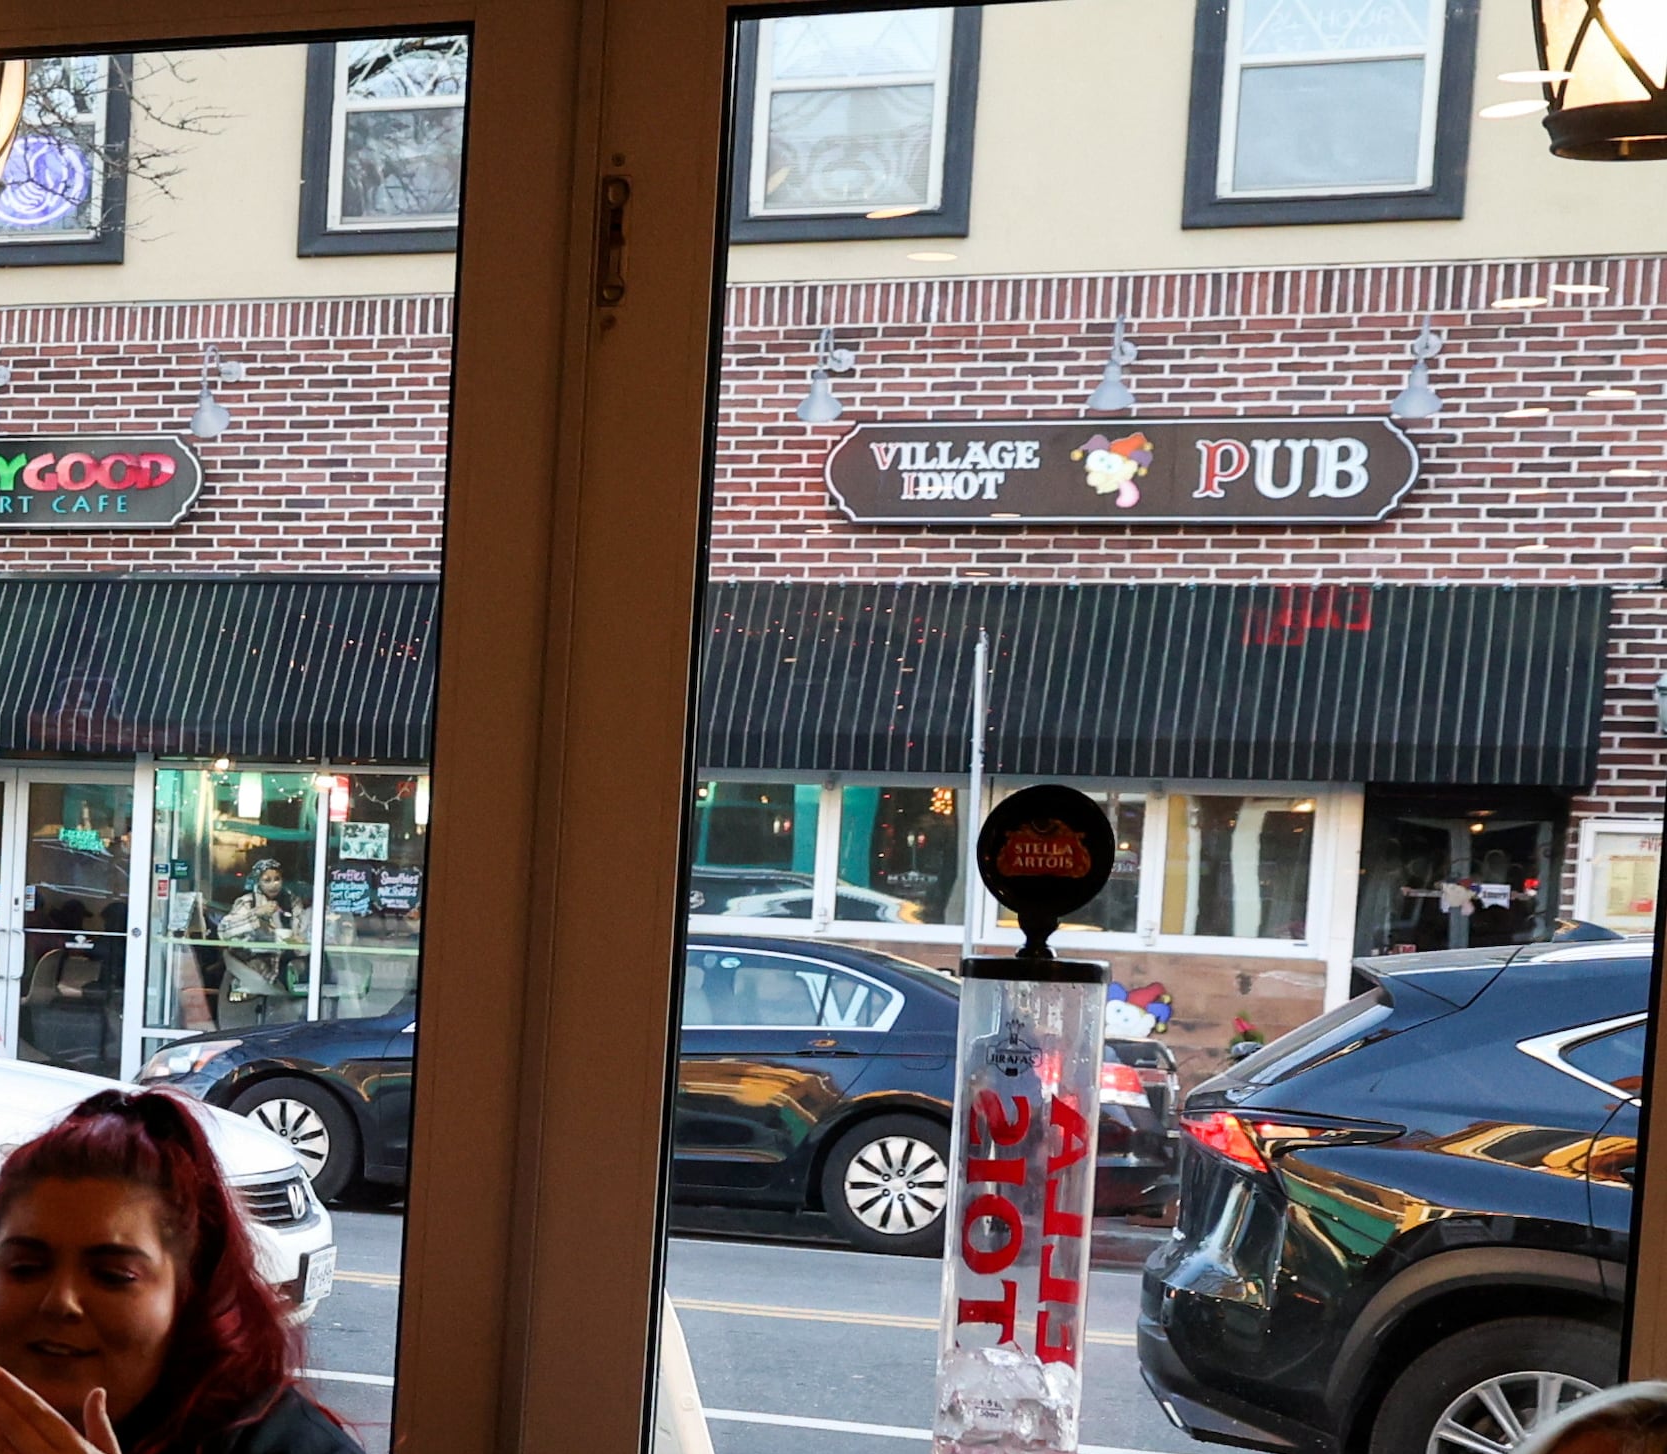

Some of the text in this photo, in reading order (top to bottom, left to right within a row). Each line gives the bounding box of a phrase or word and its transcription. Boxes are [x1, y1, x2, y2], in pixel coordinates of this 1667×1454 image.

[869, 440, 1041, 471] VILLAGE
[1192, 437, 1372, 500] PUB
[900, 471, 1005, 501] IDIOT
[51, 494, 129, 514] CAFE
[1014, 842, 1074, 856] STELLA
[1012, 856, 1074, 870] ARTOIS
